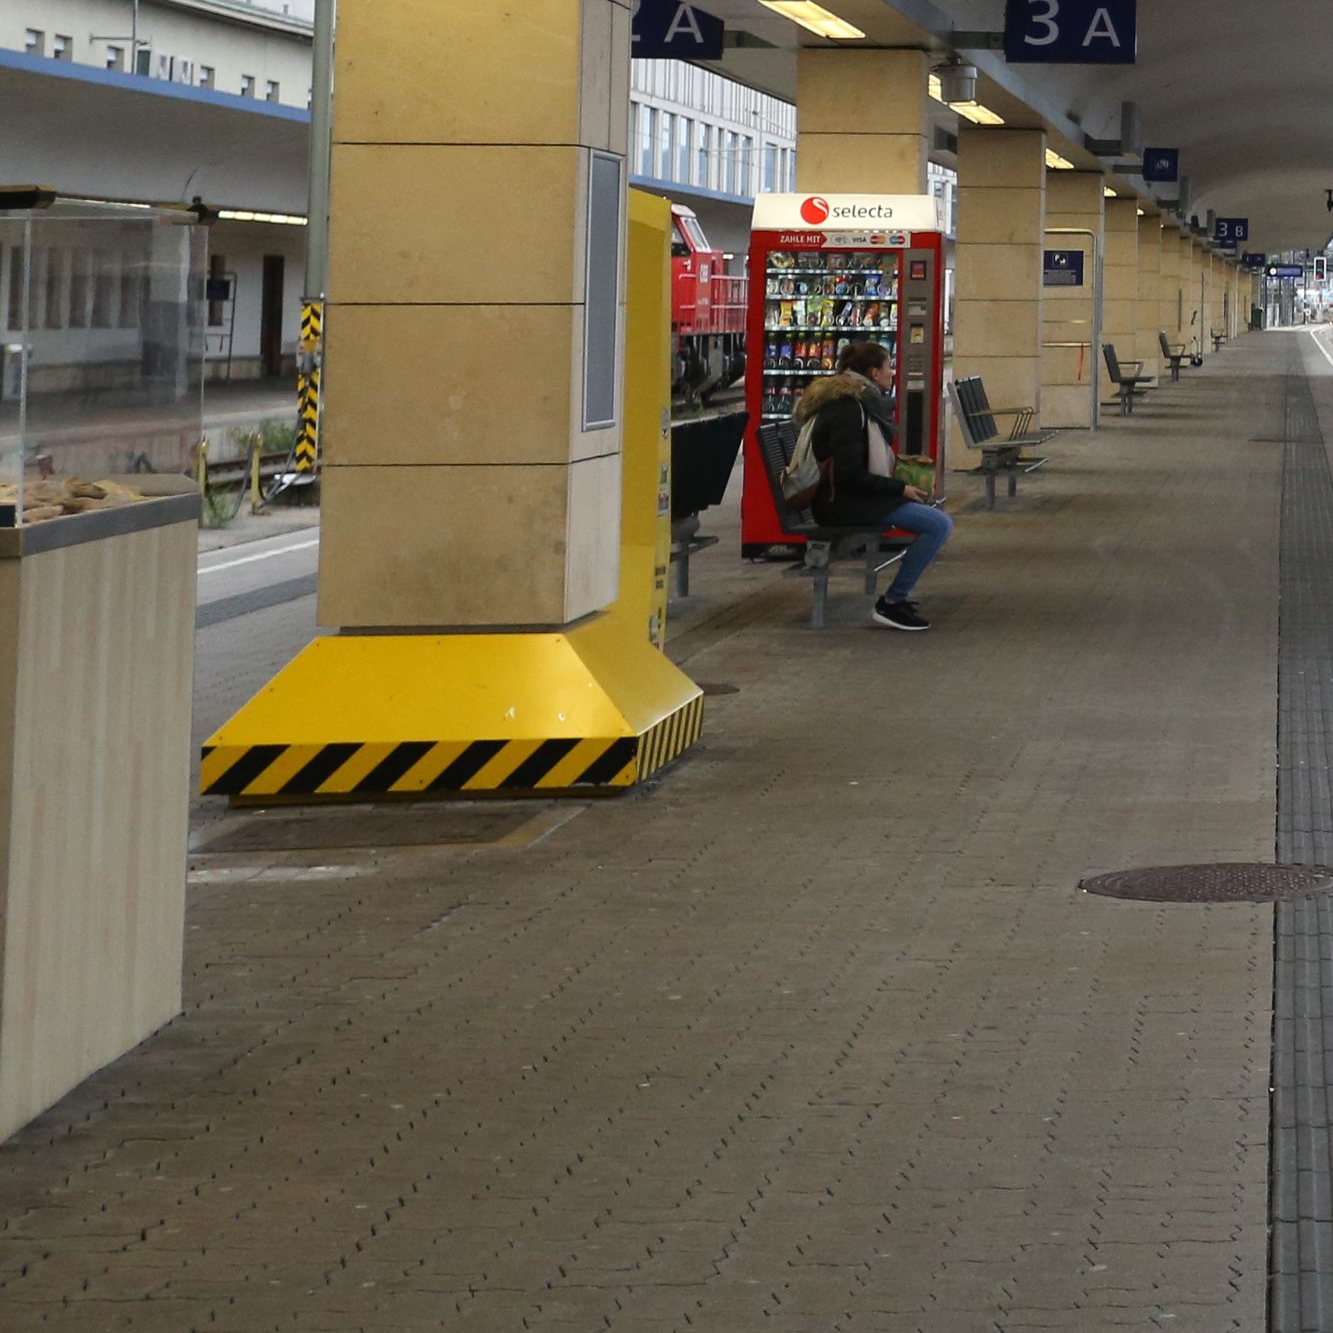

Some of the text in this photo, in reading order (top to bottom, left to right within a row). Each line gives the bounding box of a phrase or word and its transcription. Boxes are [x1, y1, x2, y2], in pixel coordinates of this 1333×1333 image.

[664, 3, 704, 43] A
[1082, 6, 1121, 47] A
[832, 204, 893, 219] selecta
[1218, 222, 1244, 237] 3 B
[780, 235, 820, 244] ZAHLE MIT
